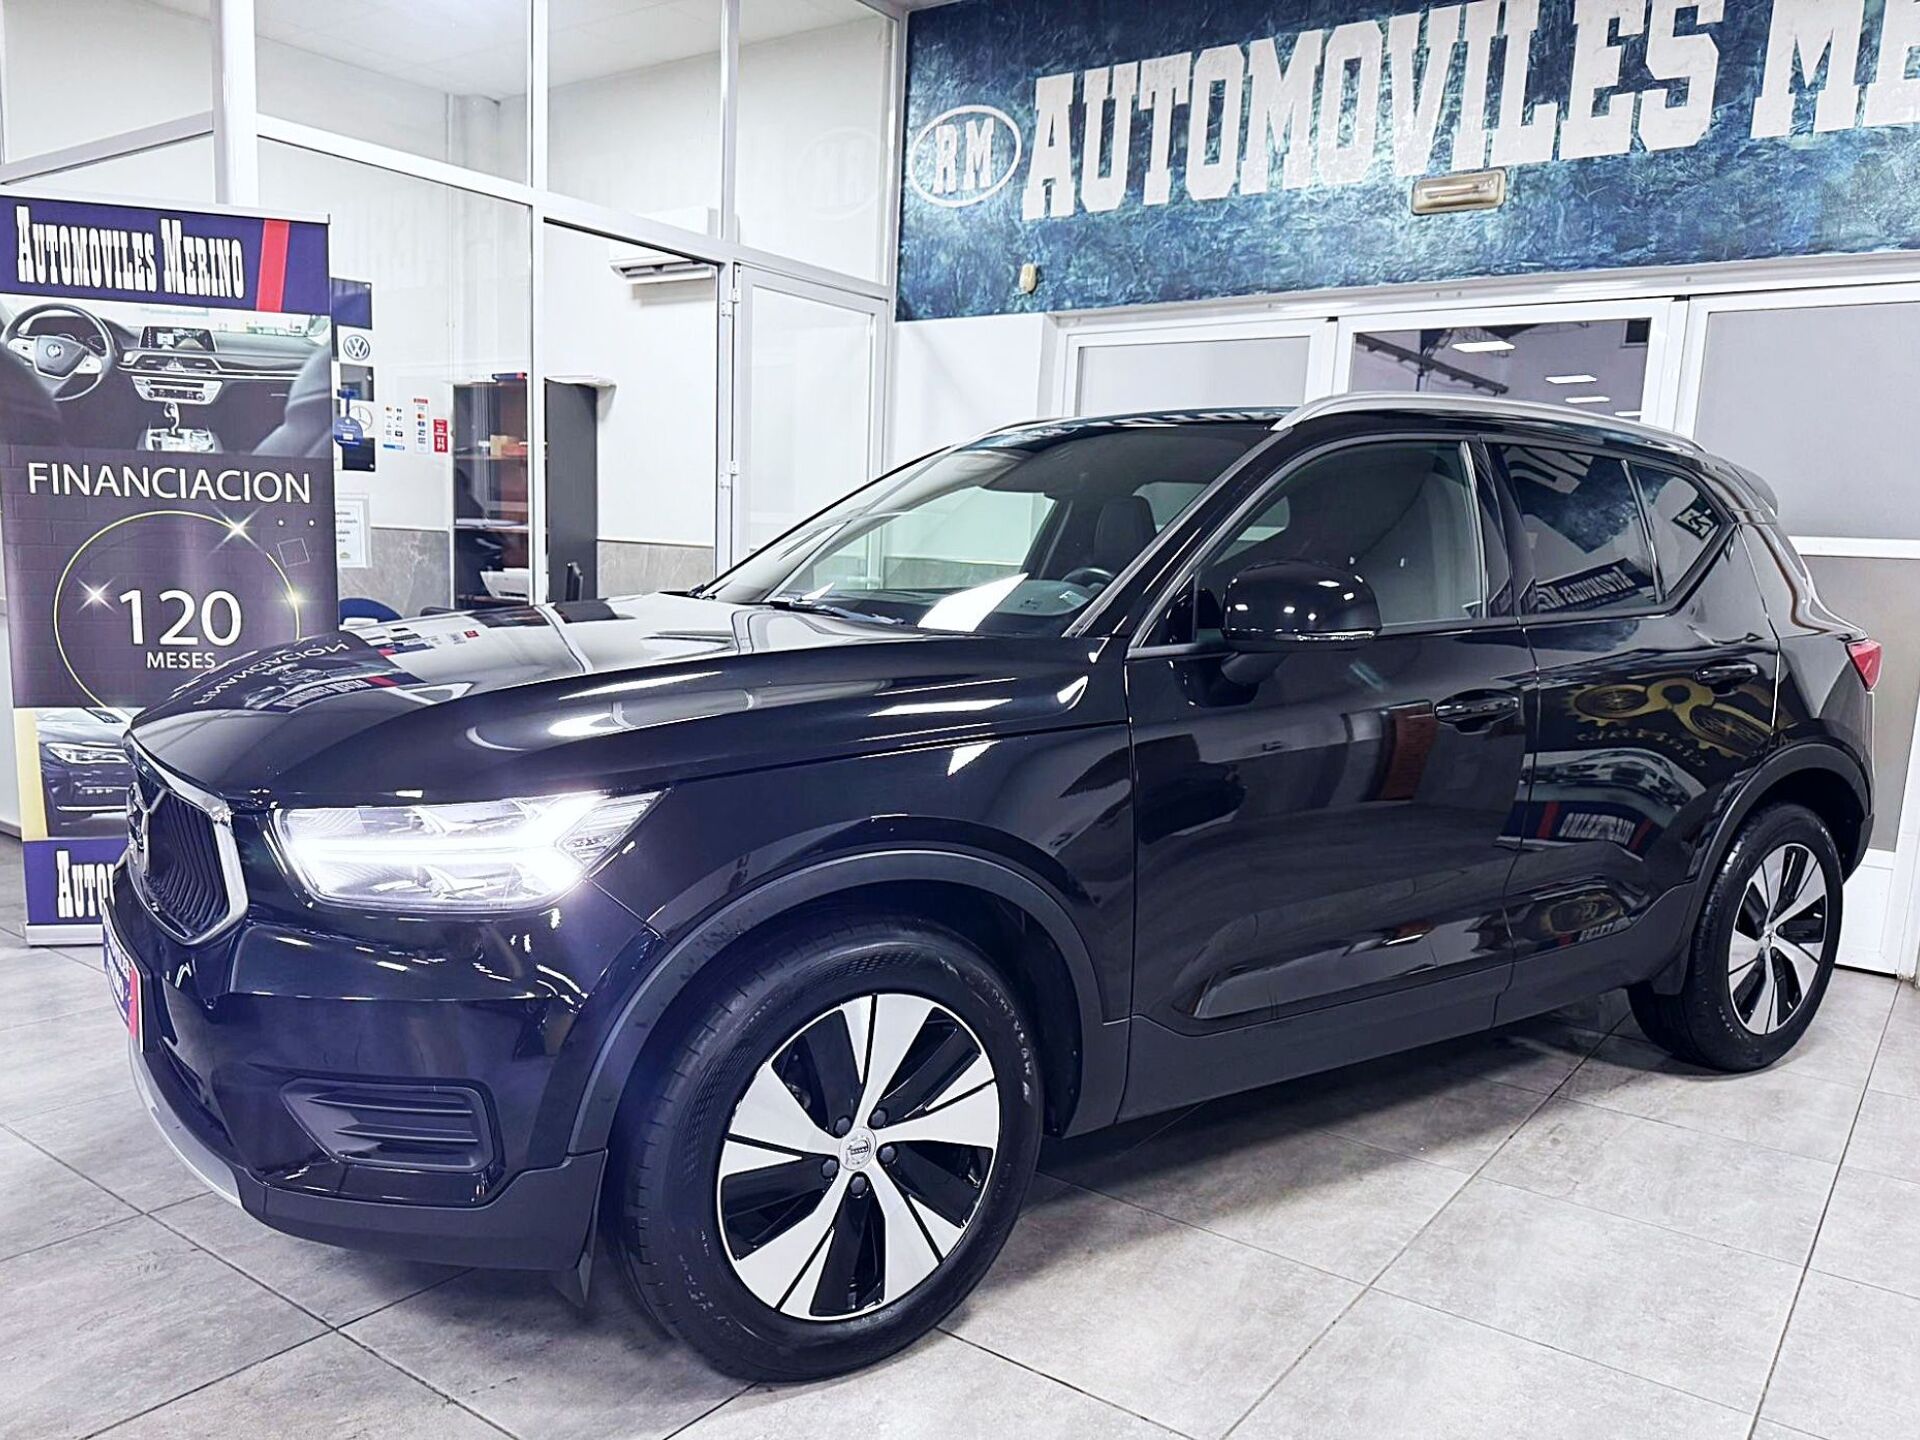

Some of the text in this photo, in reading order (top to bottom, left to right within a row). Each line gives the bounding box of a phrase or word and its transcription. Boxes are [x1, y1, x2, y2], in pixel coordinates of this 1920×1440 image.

[1022, 0, 1724, 220] AUTOMOVILES
[933, 117, 996, 193] RM
[16, 206, 244, 299] AUTOMOVILES MERINO
[28, 462, 311, 504] FINANCIACION
[119, 589, 242, 647] 120
[147, 652, 216, 669] MESES
